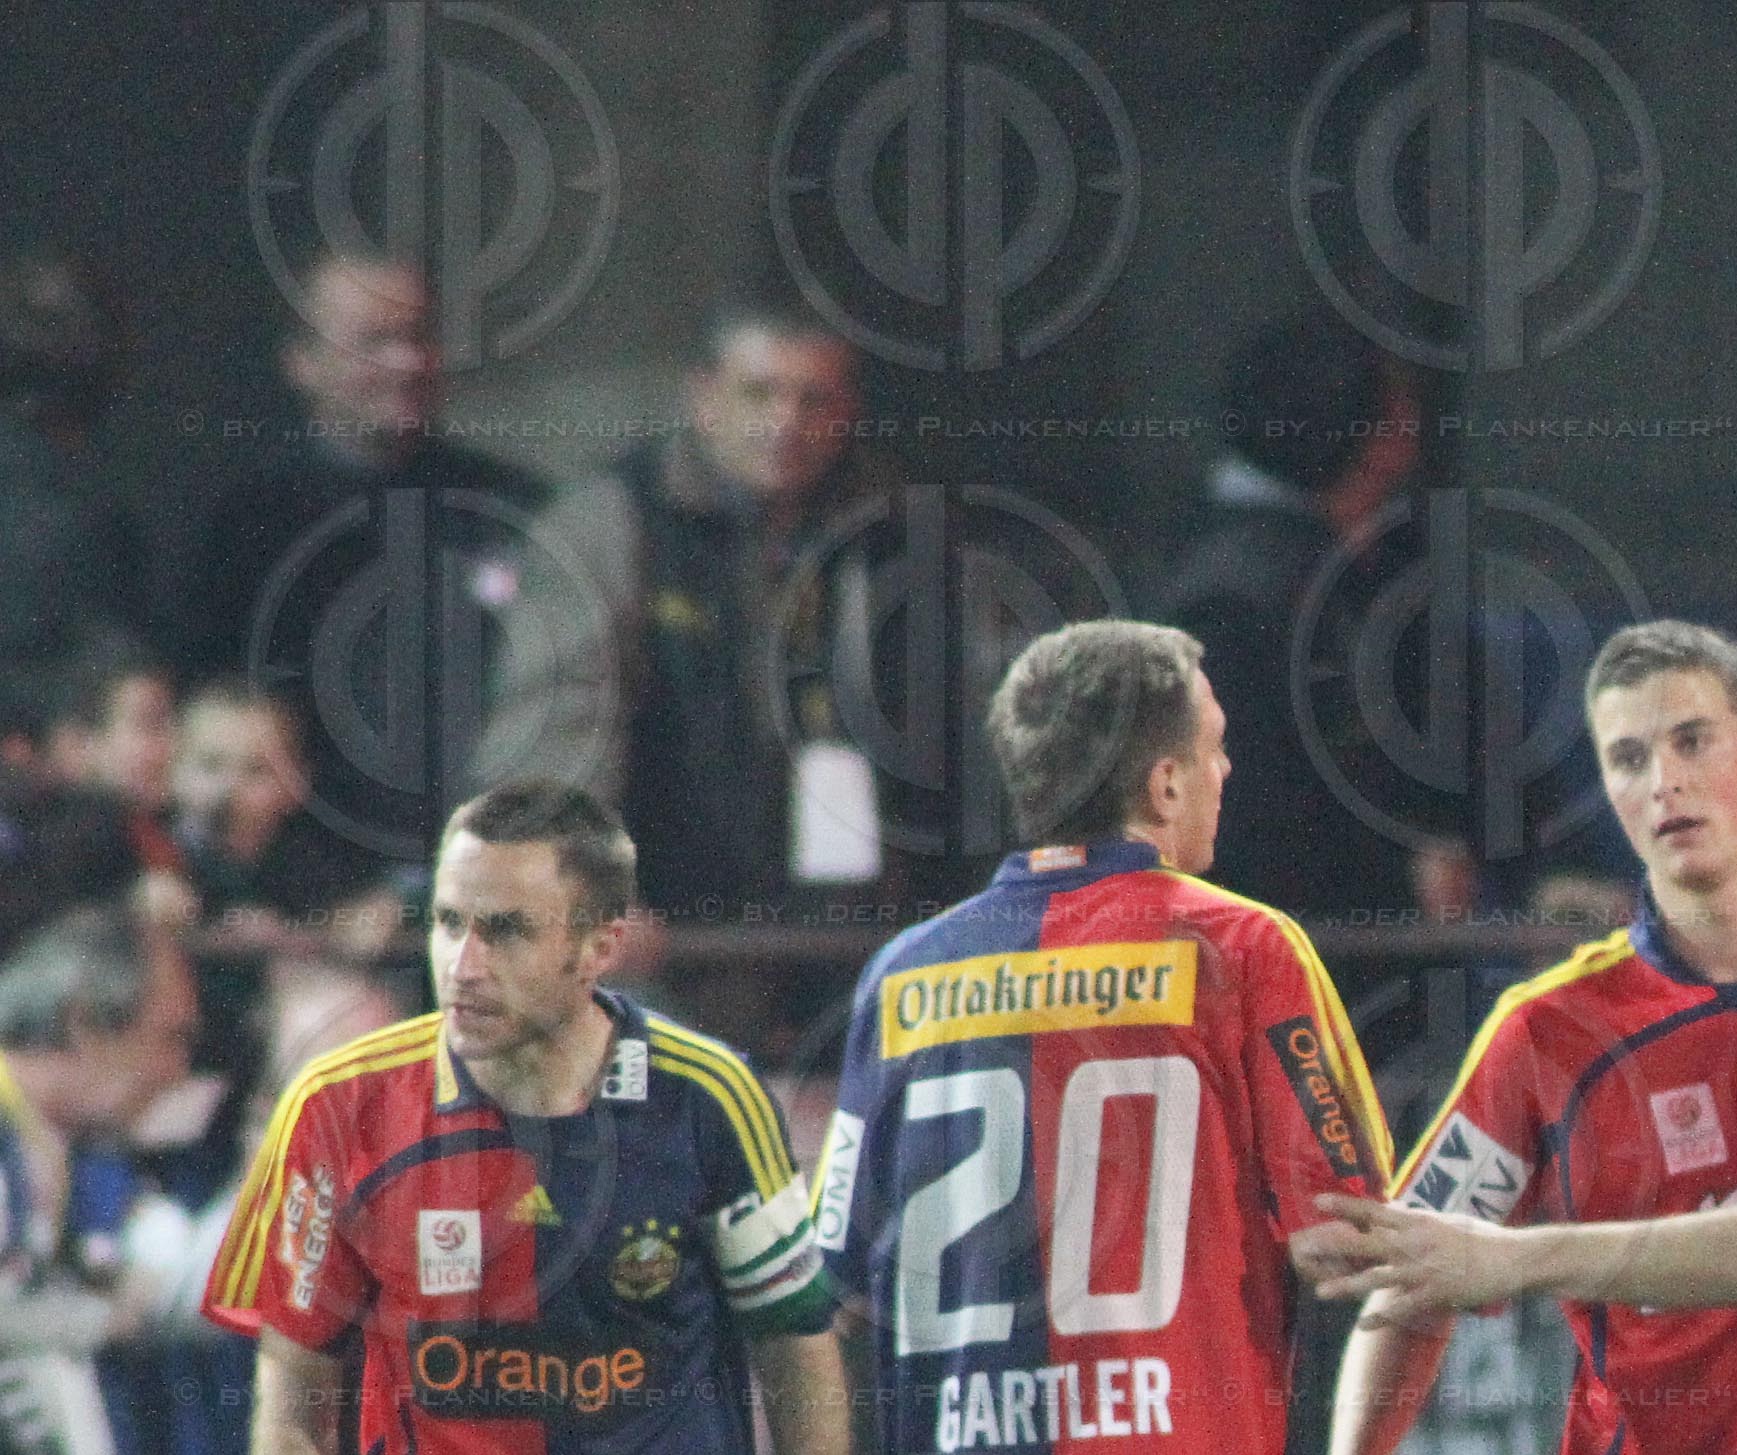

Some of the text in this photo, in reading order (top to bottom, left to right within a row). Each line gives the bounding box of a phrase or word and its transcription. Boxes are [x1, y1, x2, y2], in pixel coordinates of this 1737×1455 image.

[897, 957, 1174, 1031] Ottakringer
[1286, 1026, 1358, 1167] Orange
[820, 1127, 858, 1241] OMV
[896, 1055, 1202, 1357] 20
[416, 1334, 647, 1413] Orange
[936, 1357, 1174, 1454] GARTLER
